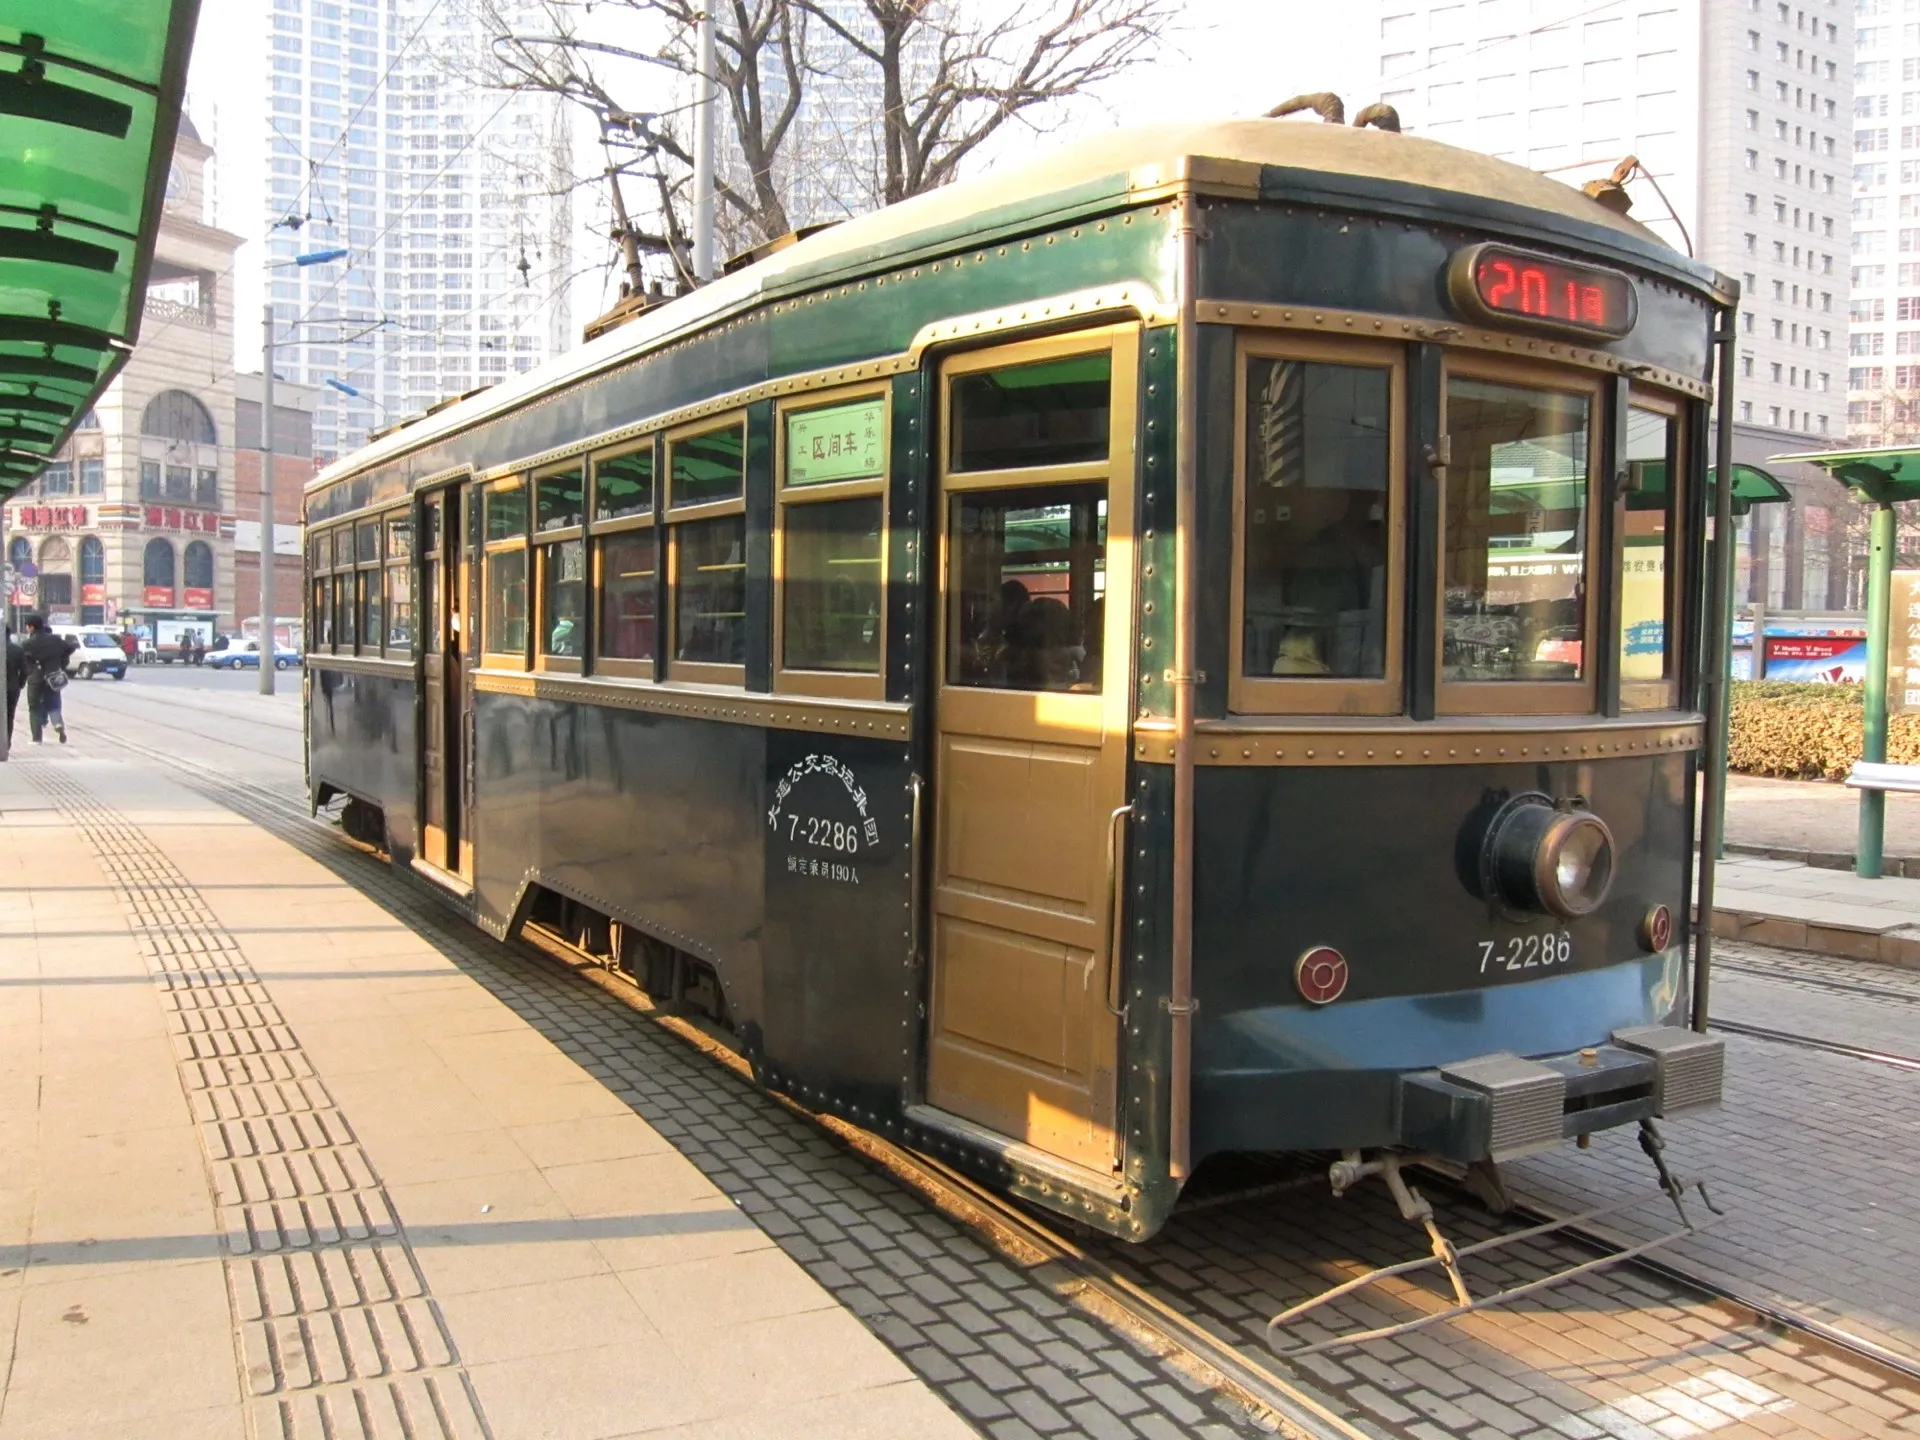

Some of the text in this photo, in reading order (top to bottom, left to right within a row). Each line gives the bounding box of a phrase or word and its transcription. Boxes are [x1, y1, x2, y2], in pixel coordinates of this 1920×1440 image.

[812, 430, 858, 460] 区间车
[864, 411, 876, 468] 华乐广场
[787, 814, 858, 853] 7-2286
[1478, 931, 1571, 973] 7-2286
